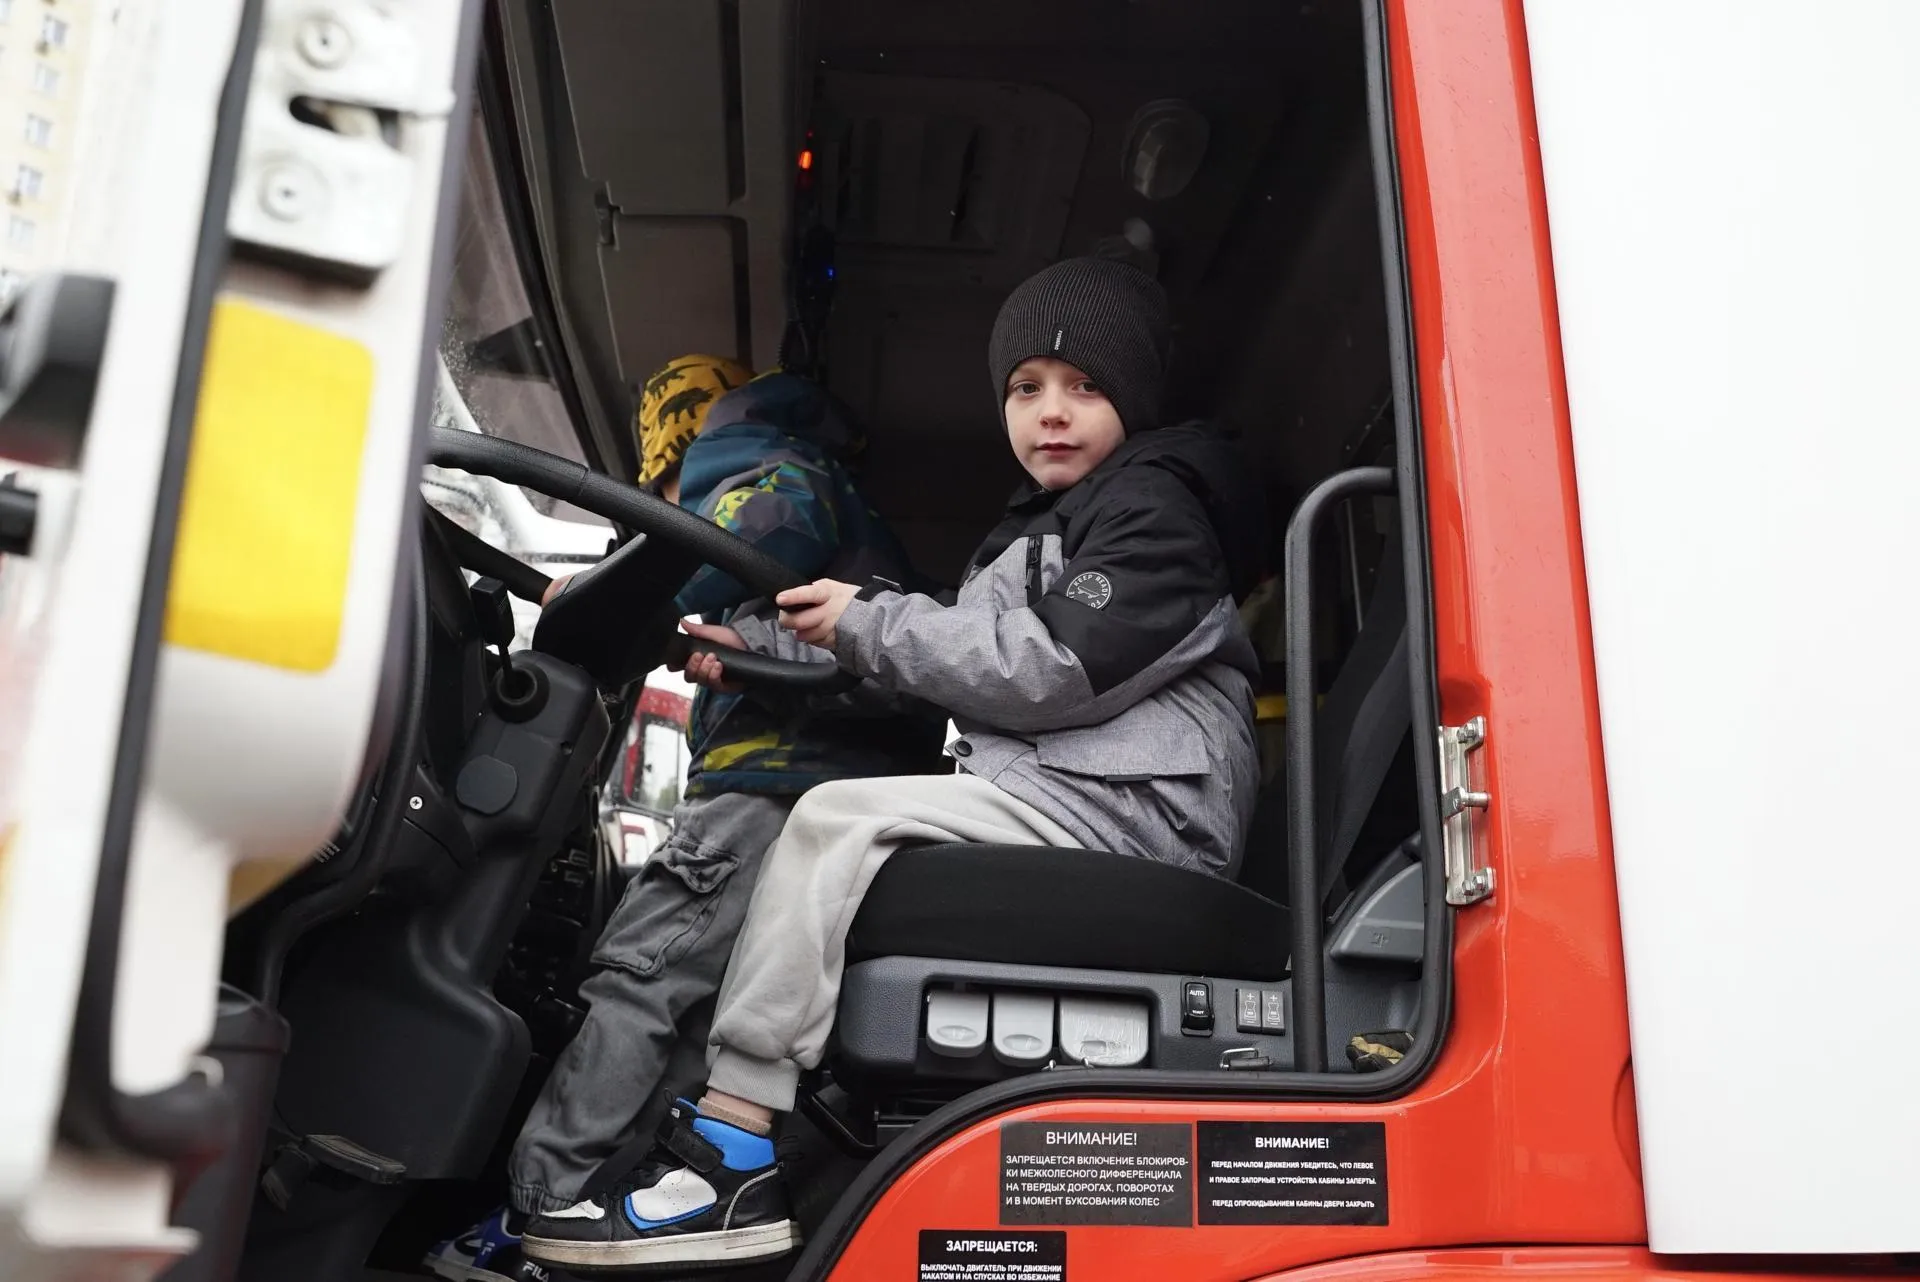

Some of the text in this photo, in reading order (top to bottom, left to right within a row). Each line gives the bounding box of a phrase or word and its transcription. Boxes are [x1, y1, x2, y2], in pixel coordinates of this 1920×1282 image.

[1074, 575, 1093, 587] KEEP
[1095, 576, 1108, 597] READY
[1189, 989, 1205, 997] AUTO
[1046, 1132, 1137, 1145] ВНИМАНИЕ!
[1255, 1137, 1329, 1148] ВНИМАНИЕ!
[1006, 1155, 1188, 1166] ЗАПРЕЩАЕТСЯ ВКЛЮЧЕНИЕ БЛОКИРОВ-
[1211, 1161, 1232, 1169] ПЕРЕД
[1264, 1161, 1300, 1169] ДВИЖЕНИЯ
[1301, 1162, 1338, 1170] УБЕДИТЕСЬ,
[1006, 1169, 1182, 1180] КИ МЕЖКОЛЕСНОГО ДИФФЕРЕНЦИАЛА
[1277, 1176, 1317, 1184] УСТРОЙСТВА
[1006, 1183, 1174, 1193] НА ТВЕРДЫХ ДОРОГАХ, ПОВОРОТАХ
[1006, 1197, 1160, 1206] И В МОМЕНТ БУКСОВАНИЯ КОЛЕС
[946, 1240, 1038, 1254] ЗАПРЕЩАЕТСЯ:
[523, 1261, 549, 1282] FILA
[920, 1264, 965, 1272] ВЫКЛЮЧАТЬ
[966, 1264, 1006, 1273] ДВИГАТЕЛЬ
[1023, 1265, 1062, 1273] ДВИЖЕНИИ
